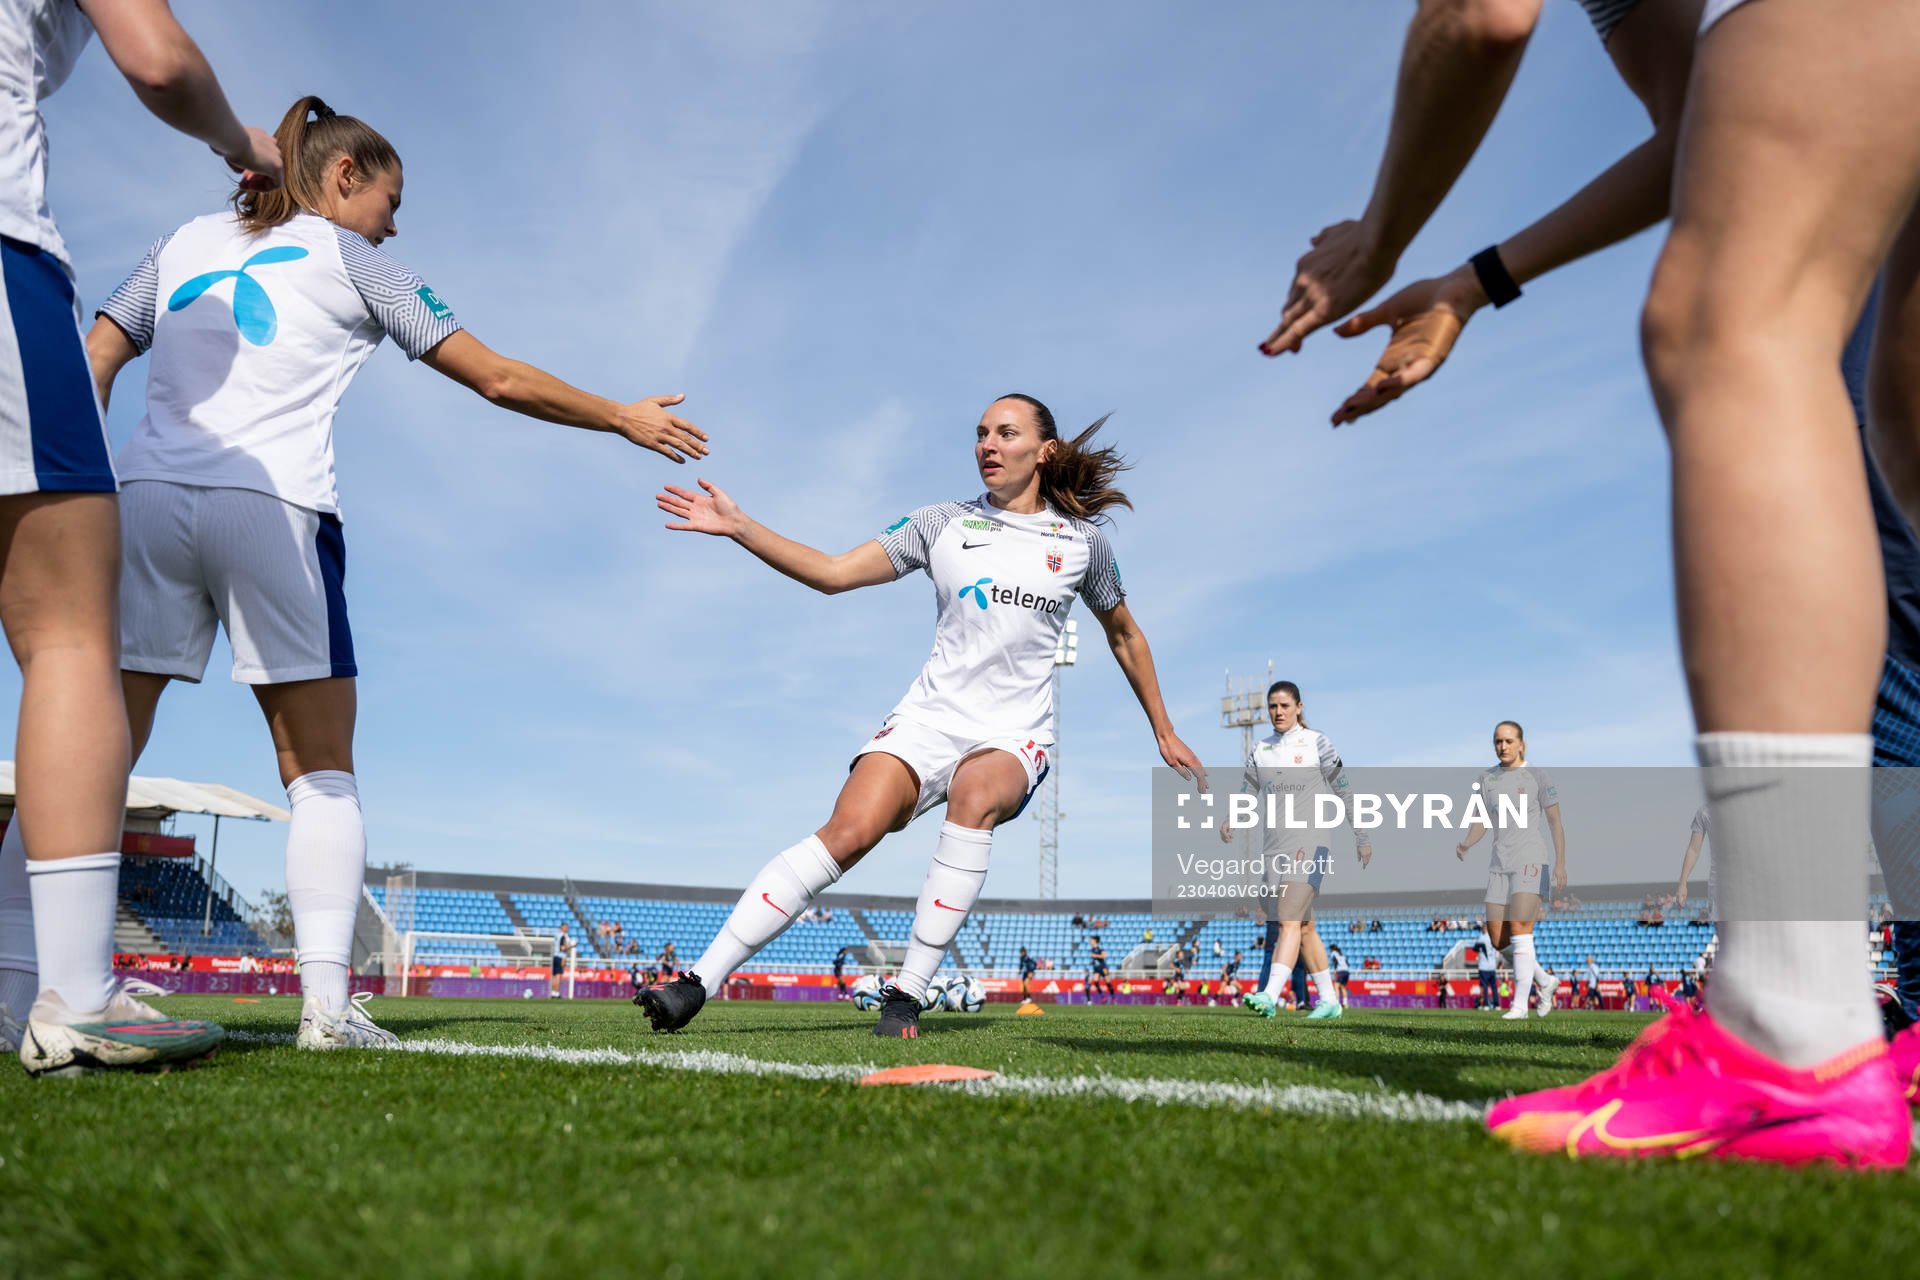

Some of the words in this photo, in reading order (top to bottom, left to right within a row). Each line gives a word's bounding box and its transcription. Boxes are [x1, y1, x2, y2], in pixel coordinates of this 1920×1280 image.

[1055, 532, 1073, 541] Tipping
[991, 584, 1062, 615] telenor
[1272, 781, 1306, 793] telenor
